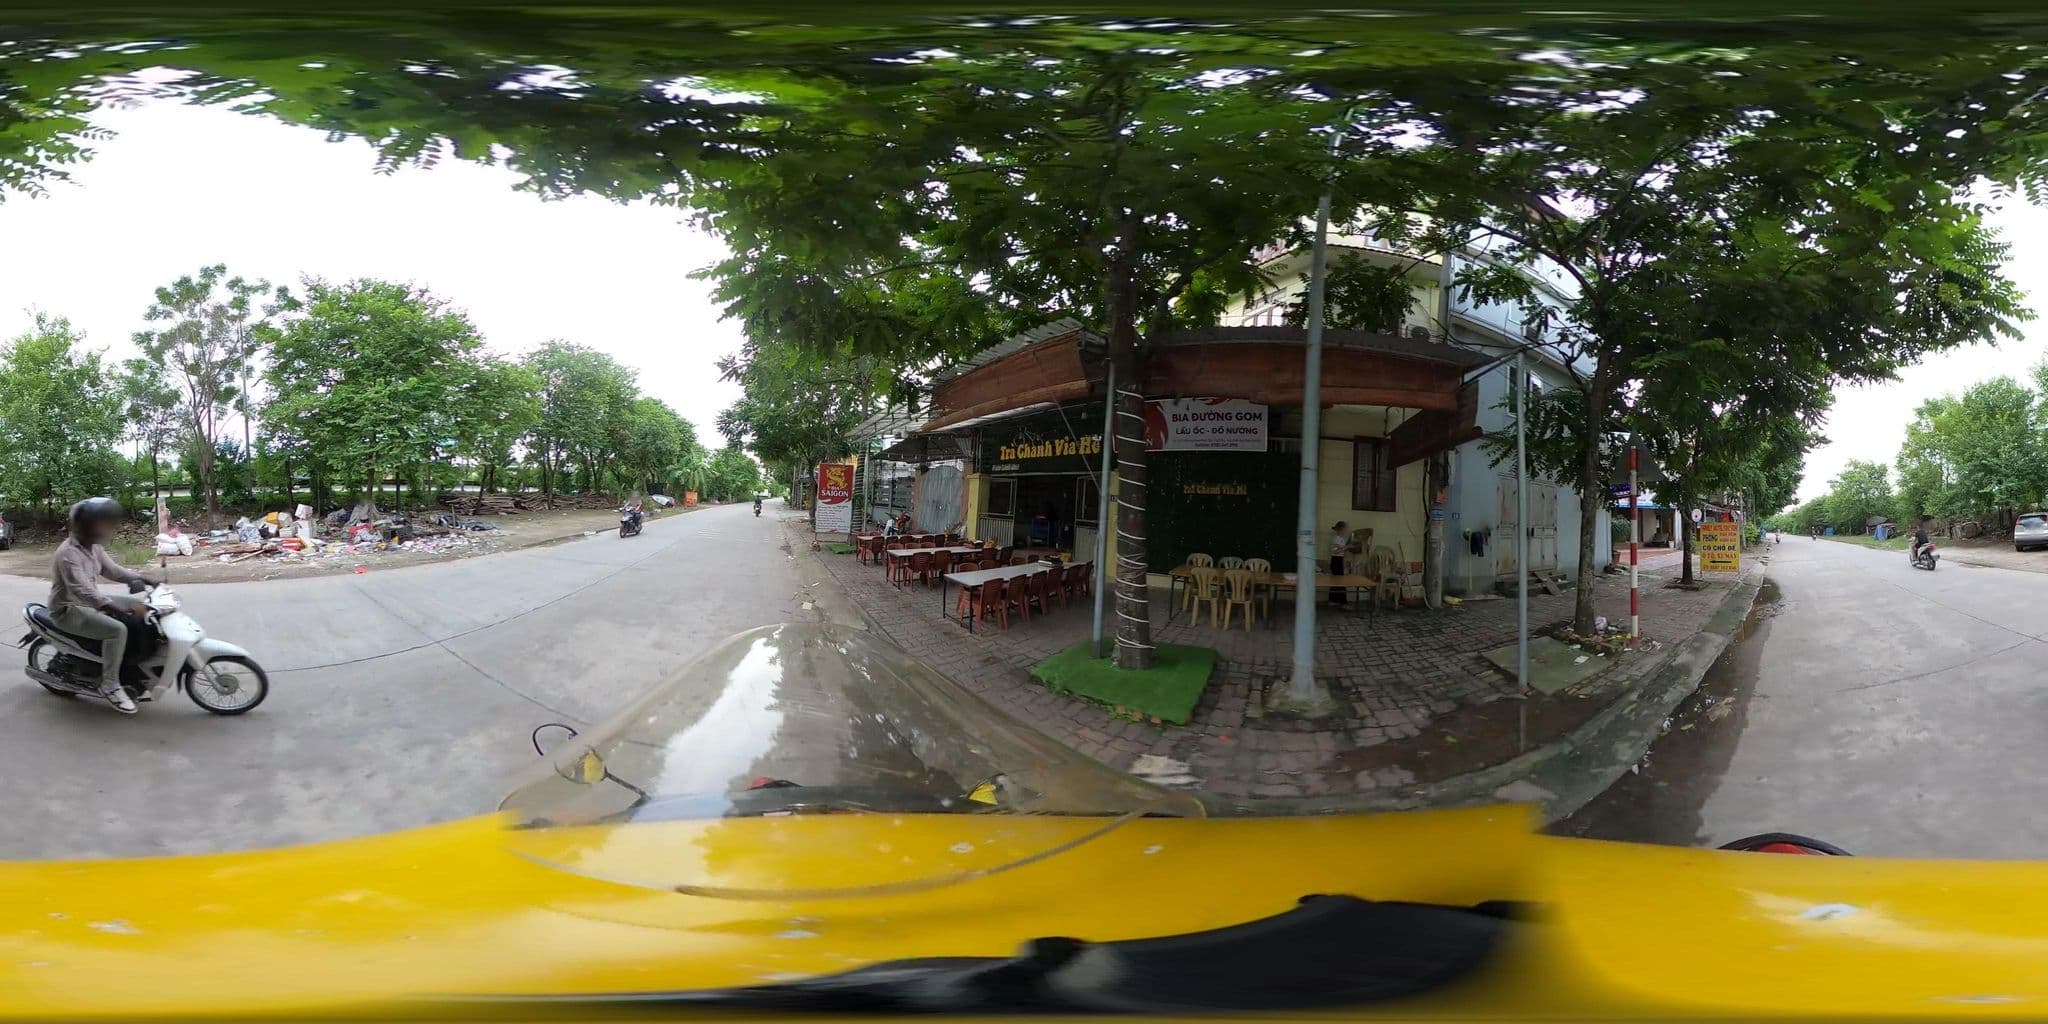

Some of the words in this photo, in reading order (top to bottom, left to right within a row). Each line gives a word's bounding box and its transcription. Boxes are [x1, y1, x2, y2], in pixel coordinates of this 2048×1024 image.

[1171, 412, 1189, 422] BIA
[1191, 410, 1233, 422] ĐƯỜNG
[1235, 412, 1263, 422] GOM
[1000, 443, 1016, 461] Trà
[1017, 440, 1053, 459] Chanh
